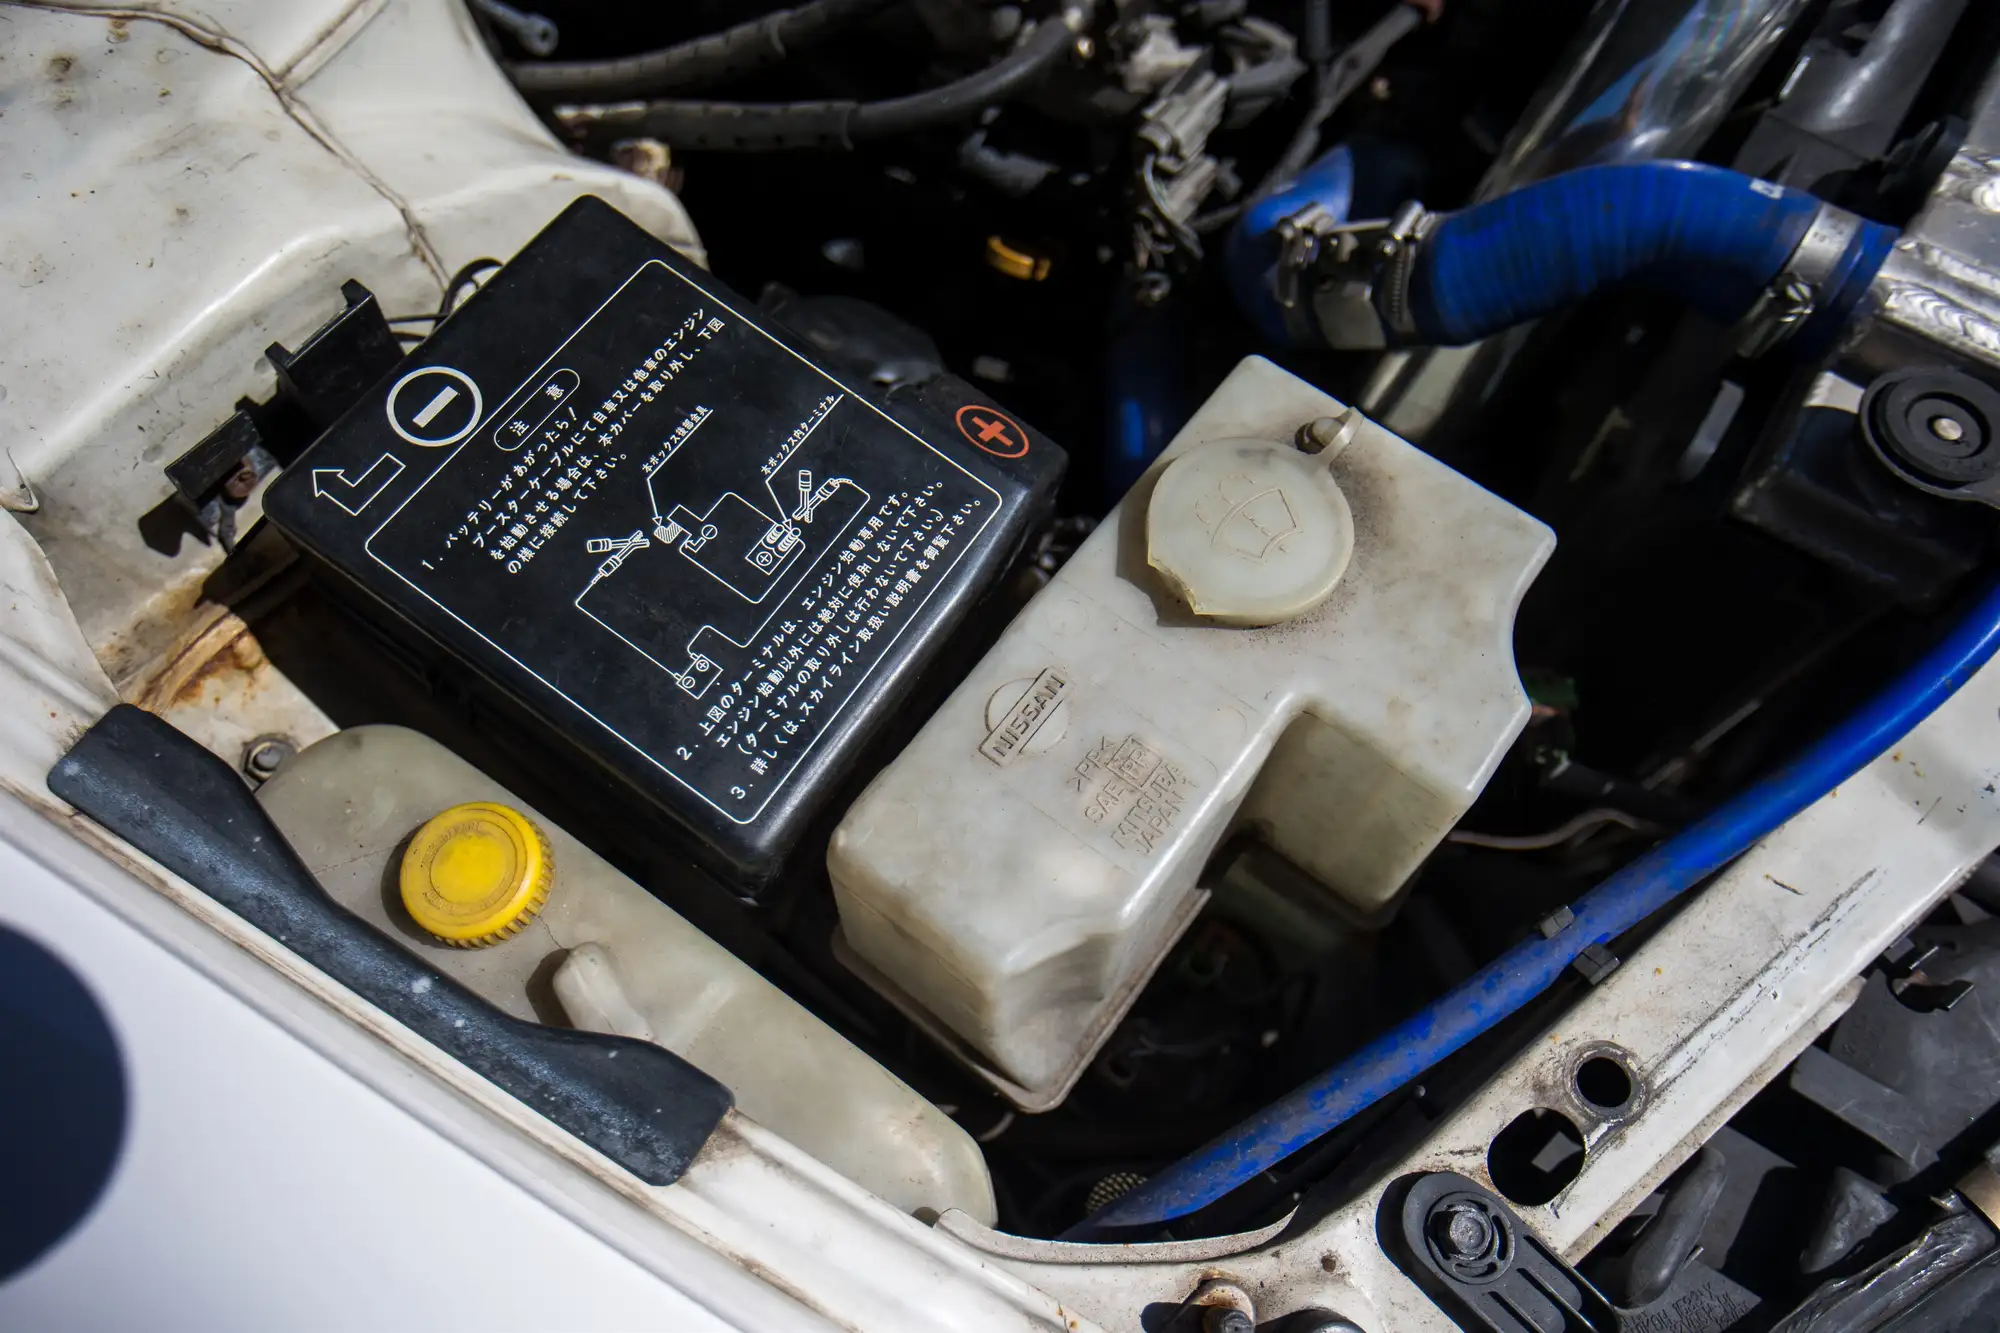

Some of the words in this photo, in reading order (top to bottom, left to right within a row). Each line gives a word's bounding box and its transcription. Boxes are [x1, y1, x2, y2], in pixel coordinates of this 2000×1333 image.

[641, 404, 709, 473] 本ボックス後部金具
[760, 394, 834, 475] 本ボックス内ターミナル
[507, 453, 627, 574] の様に接続して下さい。
[993, 674, 1065, 757] NISSAN
[1084, 780, 1125, 825] SAE
[1110, 763, 1181, 849] MITSUBA
[1135, 790, 1187, 855] JAPAN
